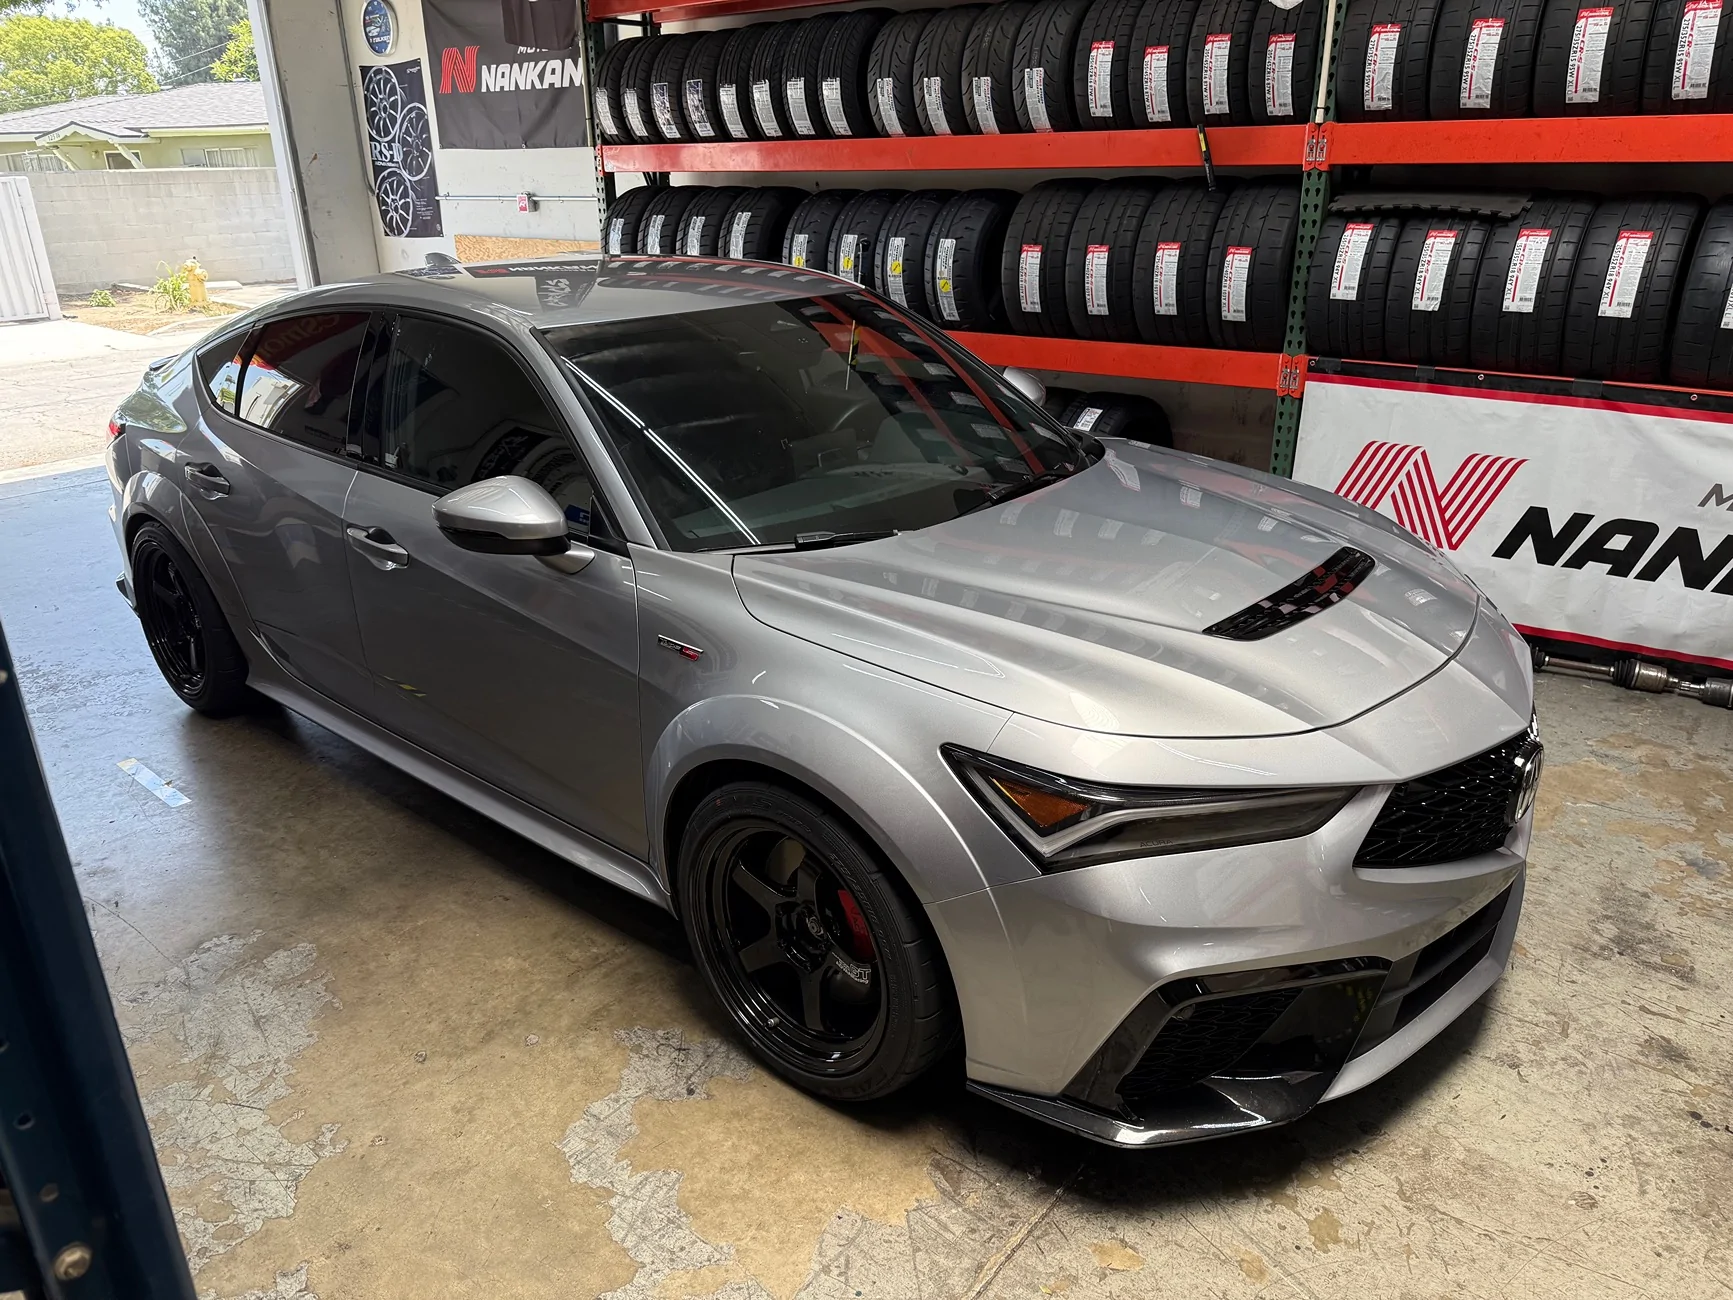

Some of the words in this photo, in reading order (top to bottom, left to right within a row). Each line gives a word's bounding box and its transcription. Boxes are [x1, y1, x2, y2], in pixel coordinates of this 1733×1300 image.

[1465, 34, 1476, 69] 275/35ZR15
[1571, 25, 1582, 61] 275/35ZR15
[1678, 19, 1690, 56] 275/35ZR15
[1366, 40, 1376, 73] 275/35ZR15
[1491, 506, 1733, 596] NAN
